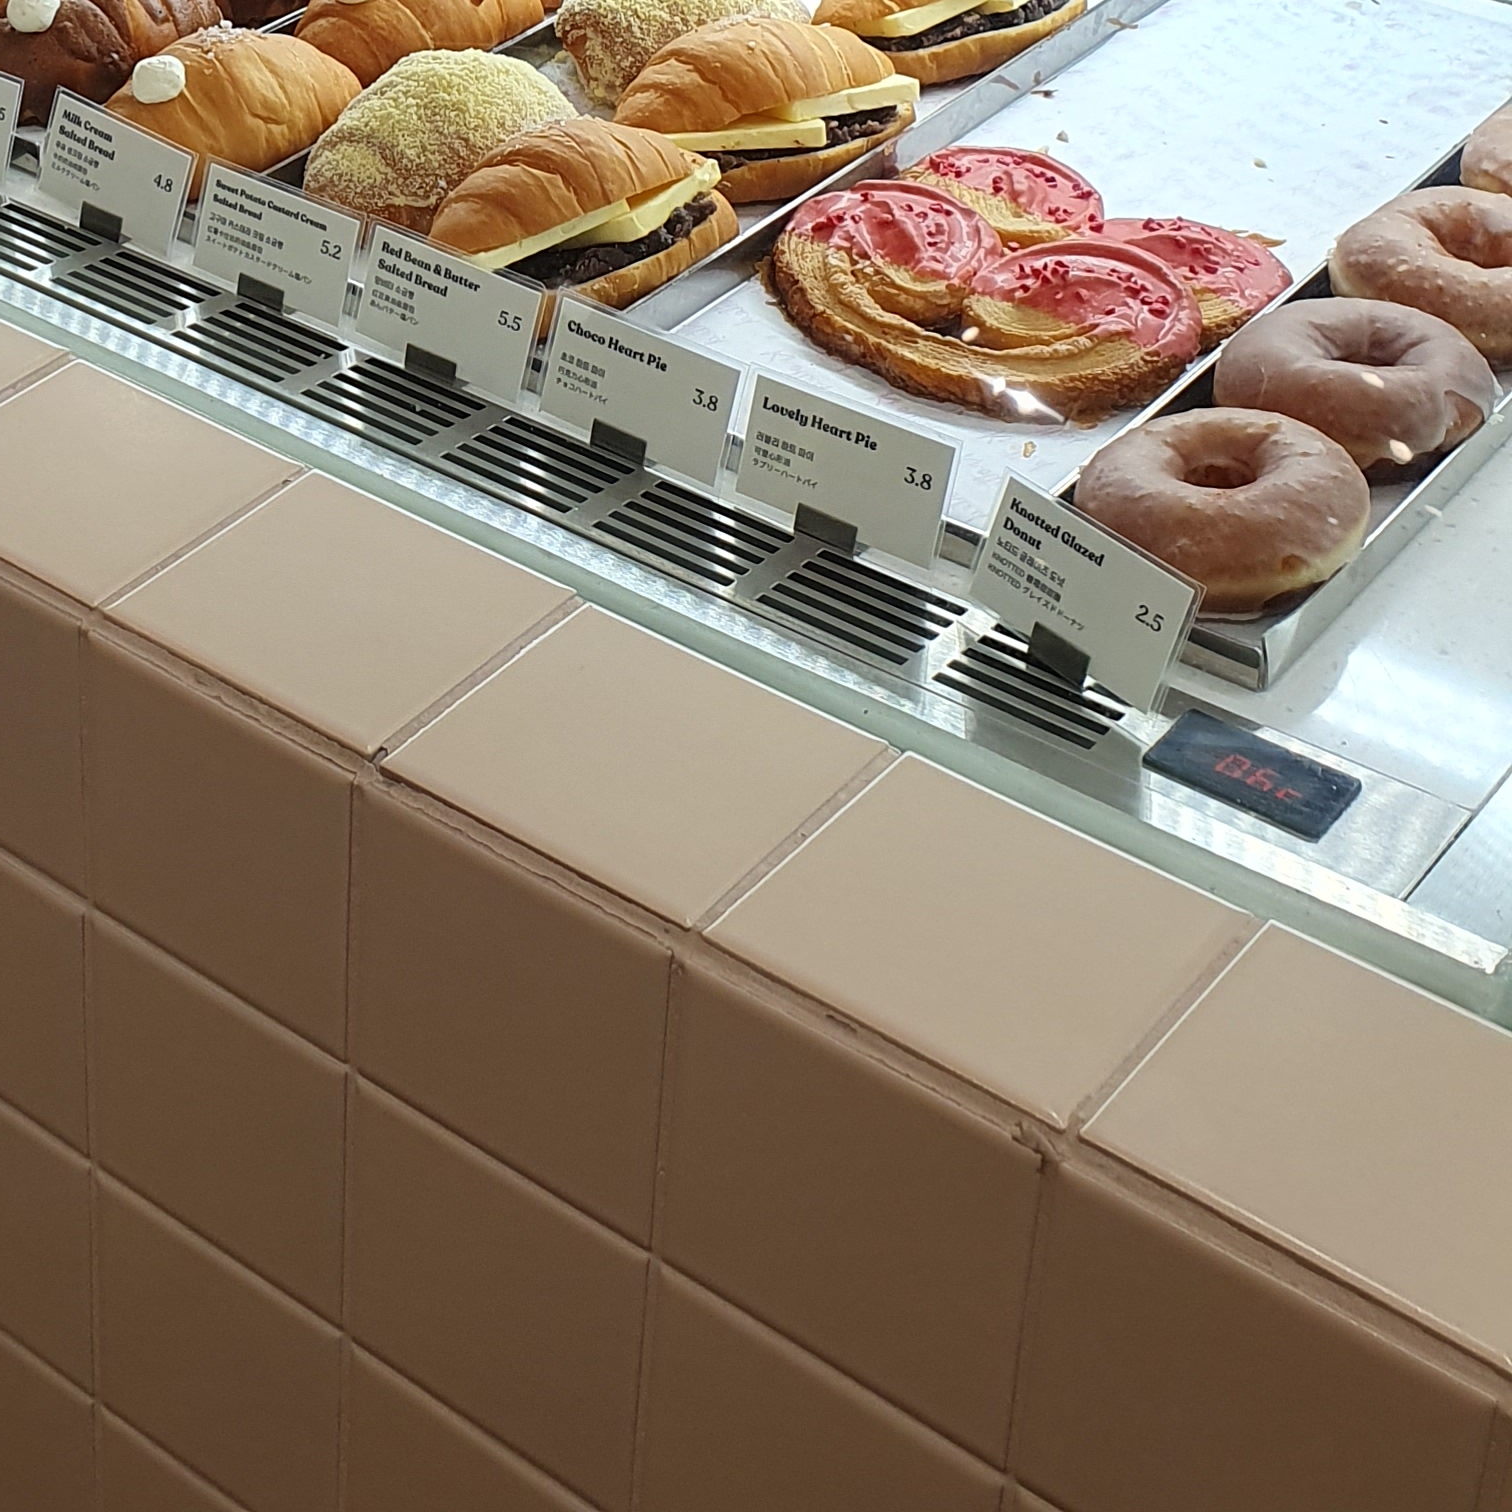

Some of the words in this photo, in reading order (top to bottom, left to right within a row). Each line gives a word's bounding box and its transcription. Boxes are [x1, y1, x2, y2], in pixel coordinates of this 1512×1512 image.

[58, 125, 88, 147] Salted
[88, 139, 115, 161] Bread
[62, 109, 82, 128] Milk
[83, 120, 113, 143] Cream
[153, 174, 173, 193] 4.8
[213, 194, 238, 210] Salted
[239, 204, 263, 221] Bread
[216, 179, 239, 196] Sweet
[240, 189, 266, 206] Potato
[268, 201, 300, 220] Custard
[300, 214, 327, 231] Cream
[320, 240, 342, 260] 5.2
[381, 241, 402, 259] Red
[404, 252, 431, 272] Bean
[433, 264, 442, 276] &
[444, 268, 481, 292] Butter
[377, 258, 413, 282] Salted
[414, 274, 448, 297] Bread
[498, 310, 522, 331] 5.5
[567, 320, 606, 345] Choco
[608, 337, 645, 362] Heart
[647, 353, 667, 372] Pie
[692, 388, 719, 412] 3.8
[756, 431, 780, 448] 러블리
[762, 396, 808, 427] Lovely
[811, 415, 852, 441] Heart
[854, 432, 878, 451] Pie
[752, 458, 819, 489] ラブリーハートパイ
[904, 466, 933, 490] 3.8
[1003, 516, 1043, 550] Donut
[1010, 498, 1061, 539] Knotted
[1061, 531, 1105, 567] Glazed
[991, 552, 1026, 578] KNOTTED
[996, 536, 1019, 557] 노티드
[1049, 570, 1066, 588] 도넛
[988, 563, 1021, 590] KNOTTED
[1022, 587, 1085, 631] グレイズドドーナツ
[1134, 604, 1164, 632] 2.5
